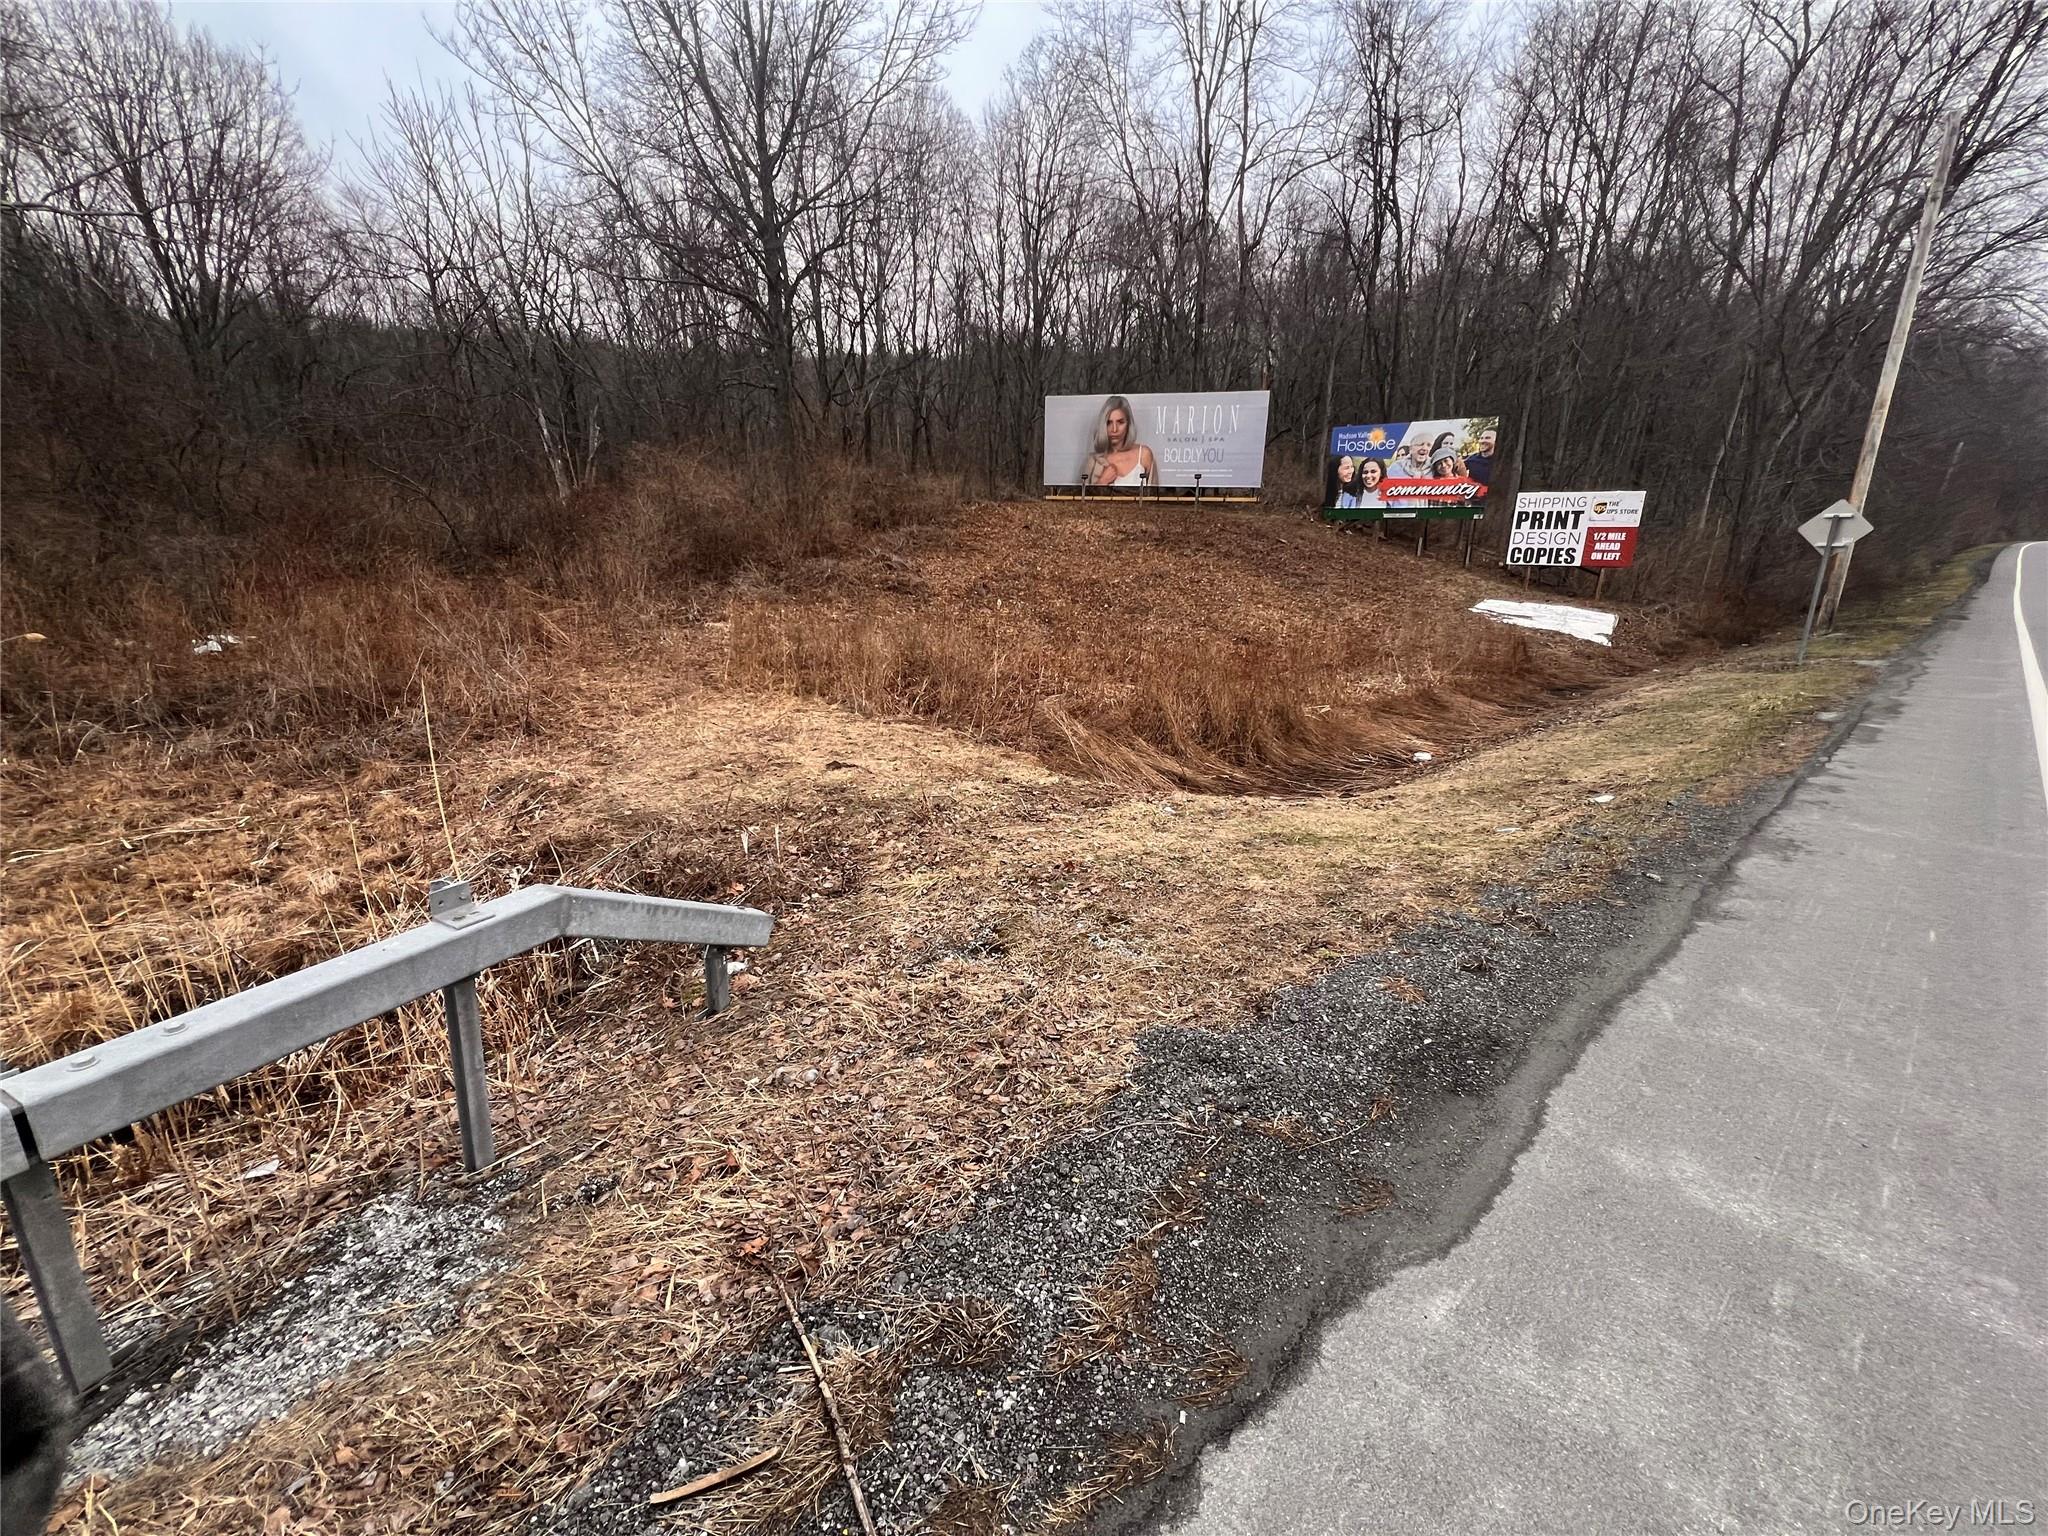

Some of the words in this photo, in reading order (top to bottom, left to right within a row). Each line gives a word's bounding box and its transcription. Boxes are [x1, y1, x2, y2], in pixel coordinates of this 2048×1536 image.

[1155, 404, 1240, 434] MARION
[1337, 439, 1396, 453] Hospice
[1386, 482, 1480, 500] community
[1518, 496, 1588, 509] SHIPPING
[1515, 510, 1585, 530] PRINT
[1512, 531, 1582, 545] DESIGN
[1593, 532, 1606, 541] 1/2
[1607, 532, 1627, 541] MILE
[1594, 542, 1621, 551] AHEAD
[1510, 547, 1577, 565] COPIES
[1590, 552, 1603, 561] ON
[1603, 552, 1621, 561] LEFT
